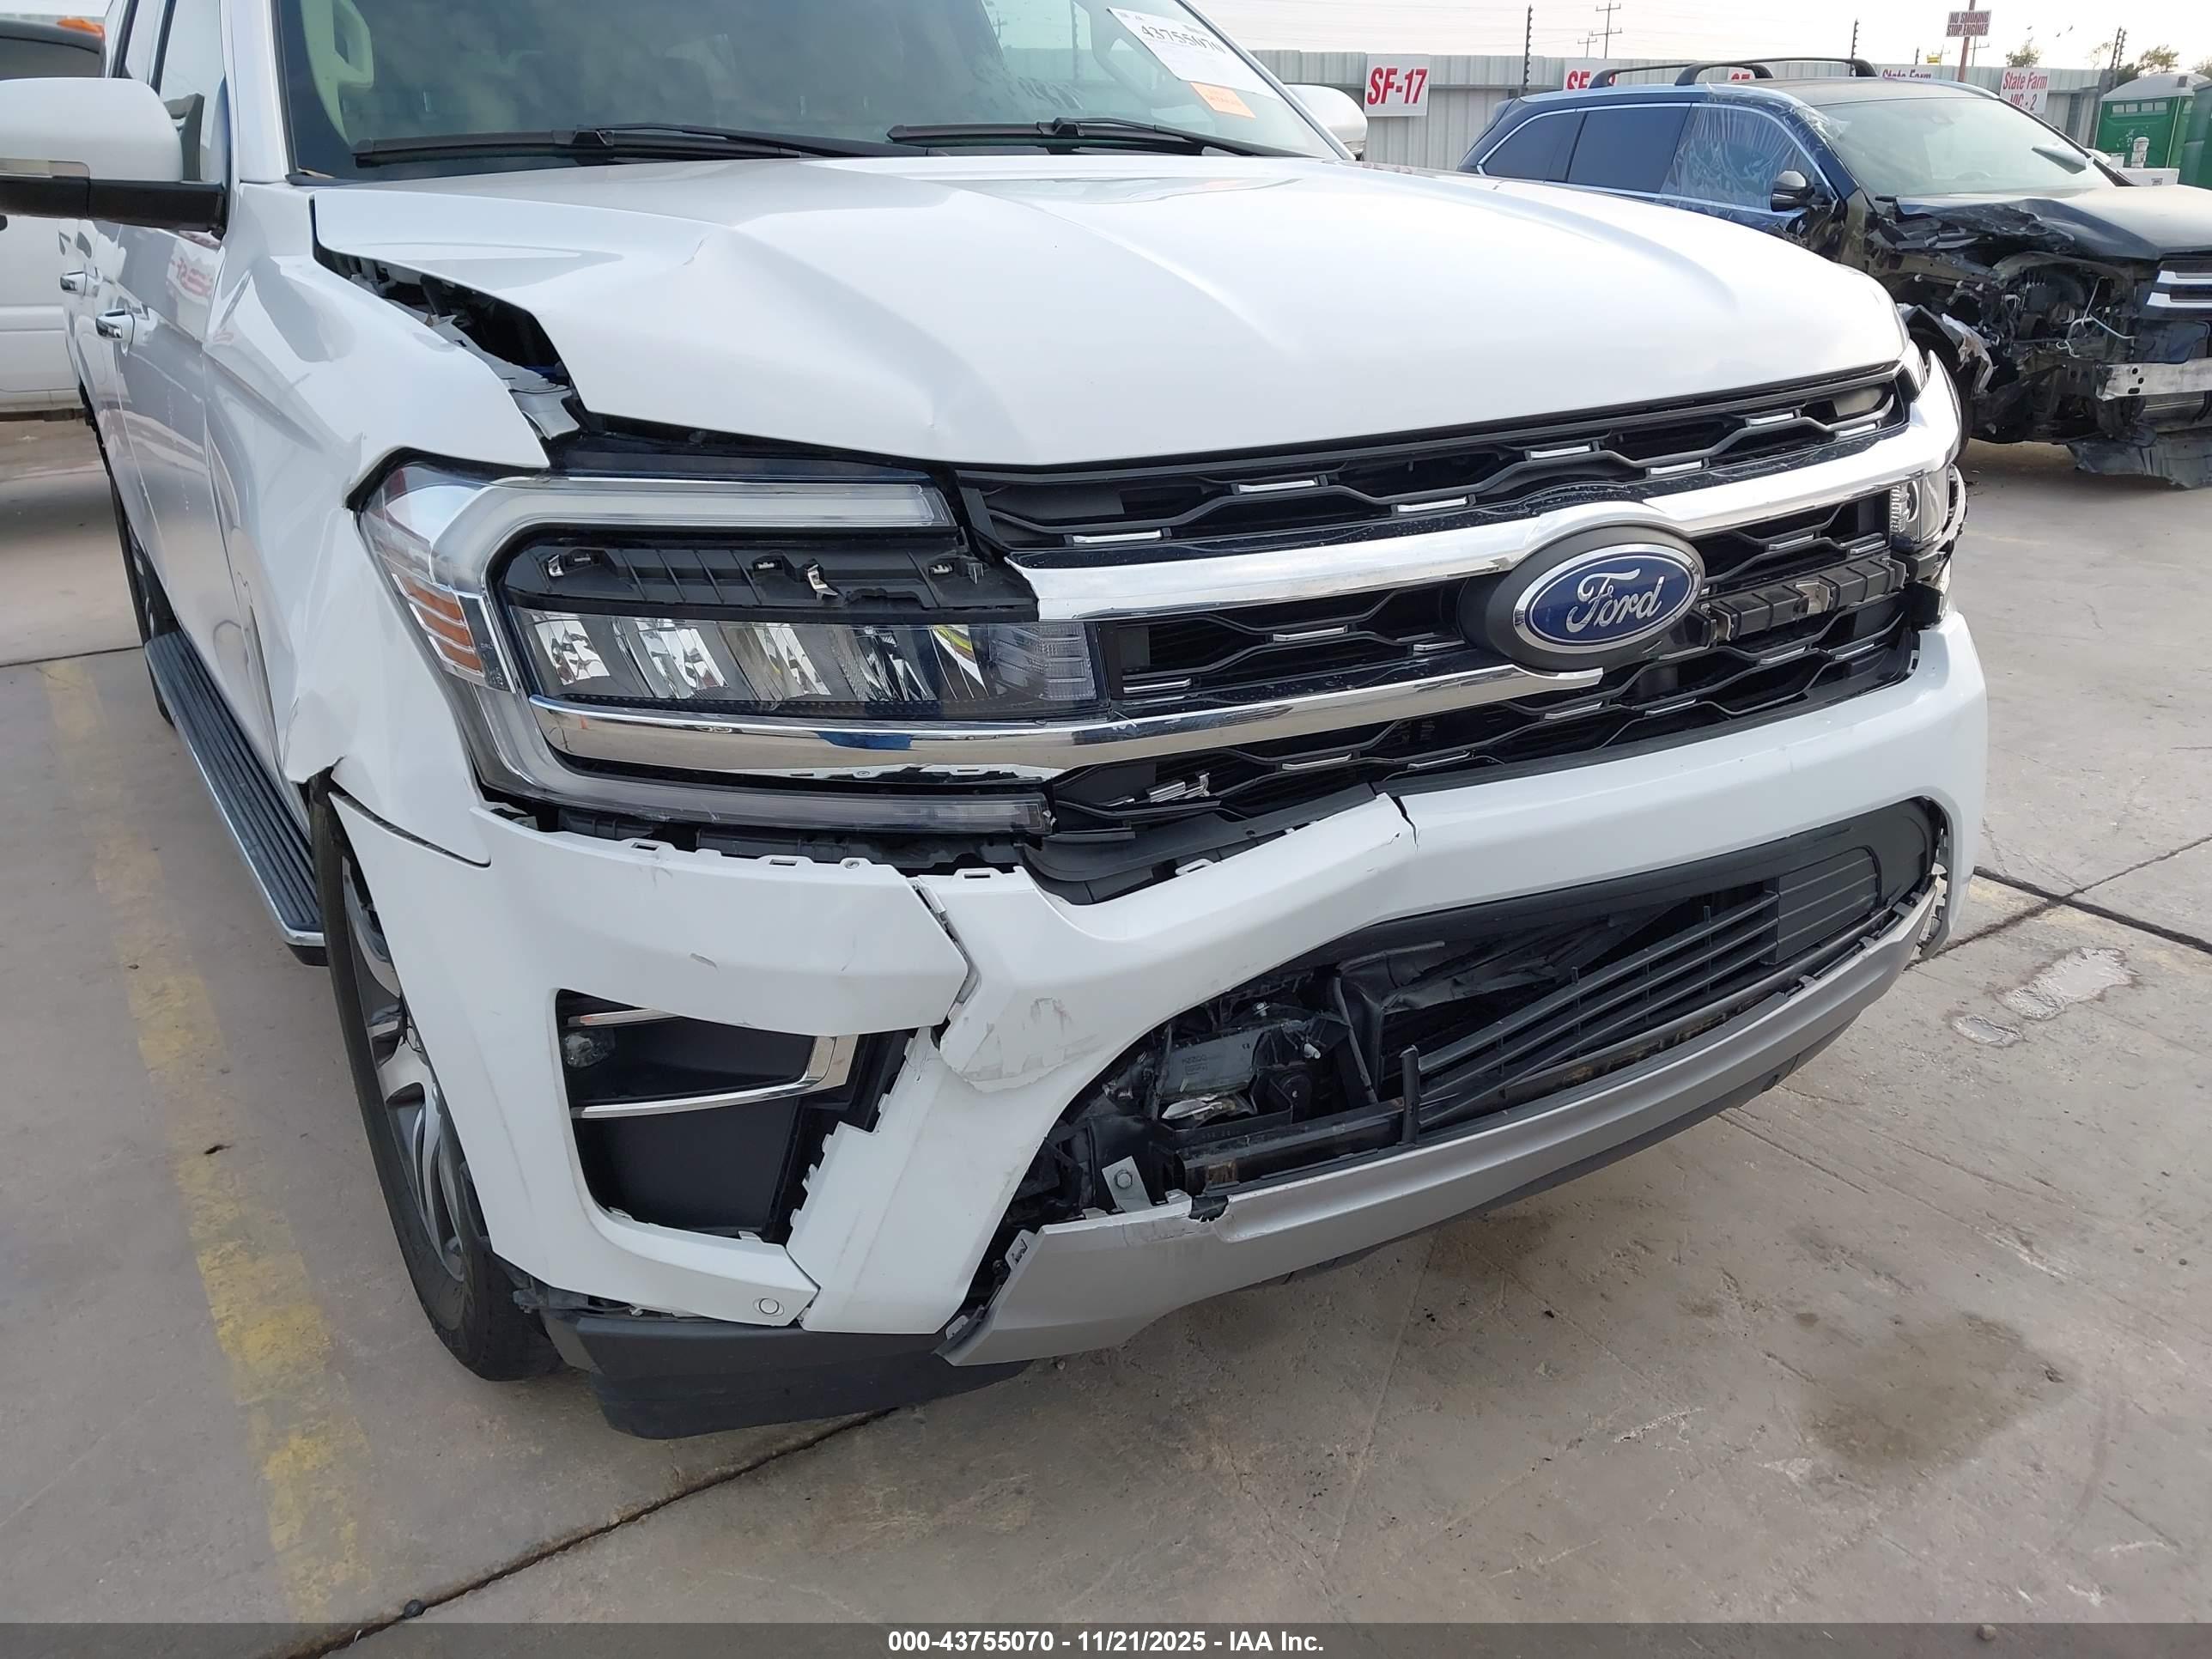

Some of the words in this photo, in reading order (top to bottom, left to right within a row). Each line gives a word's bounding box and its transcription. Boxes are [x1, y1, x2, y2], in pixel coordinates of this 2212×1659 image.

[1949, 12, 1960, 23] NO
[1960, 11, 1989, 23] SMOKING
[1946, 24, 1962, 36] STOP
[1963, 23, 1988, 35] ENGINES
[1367, 67, 1428, 105] SF-17
[2002, 71, 2026, 89] State
[2027, 71, 2048, 89] Farm
[2029, 94, 2038, 111] 2
[1566, 568, 1665, 633] Ford
